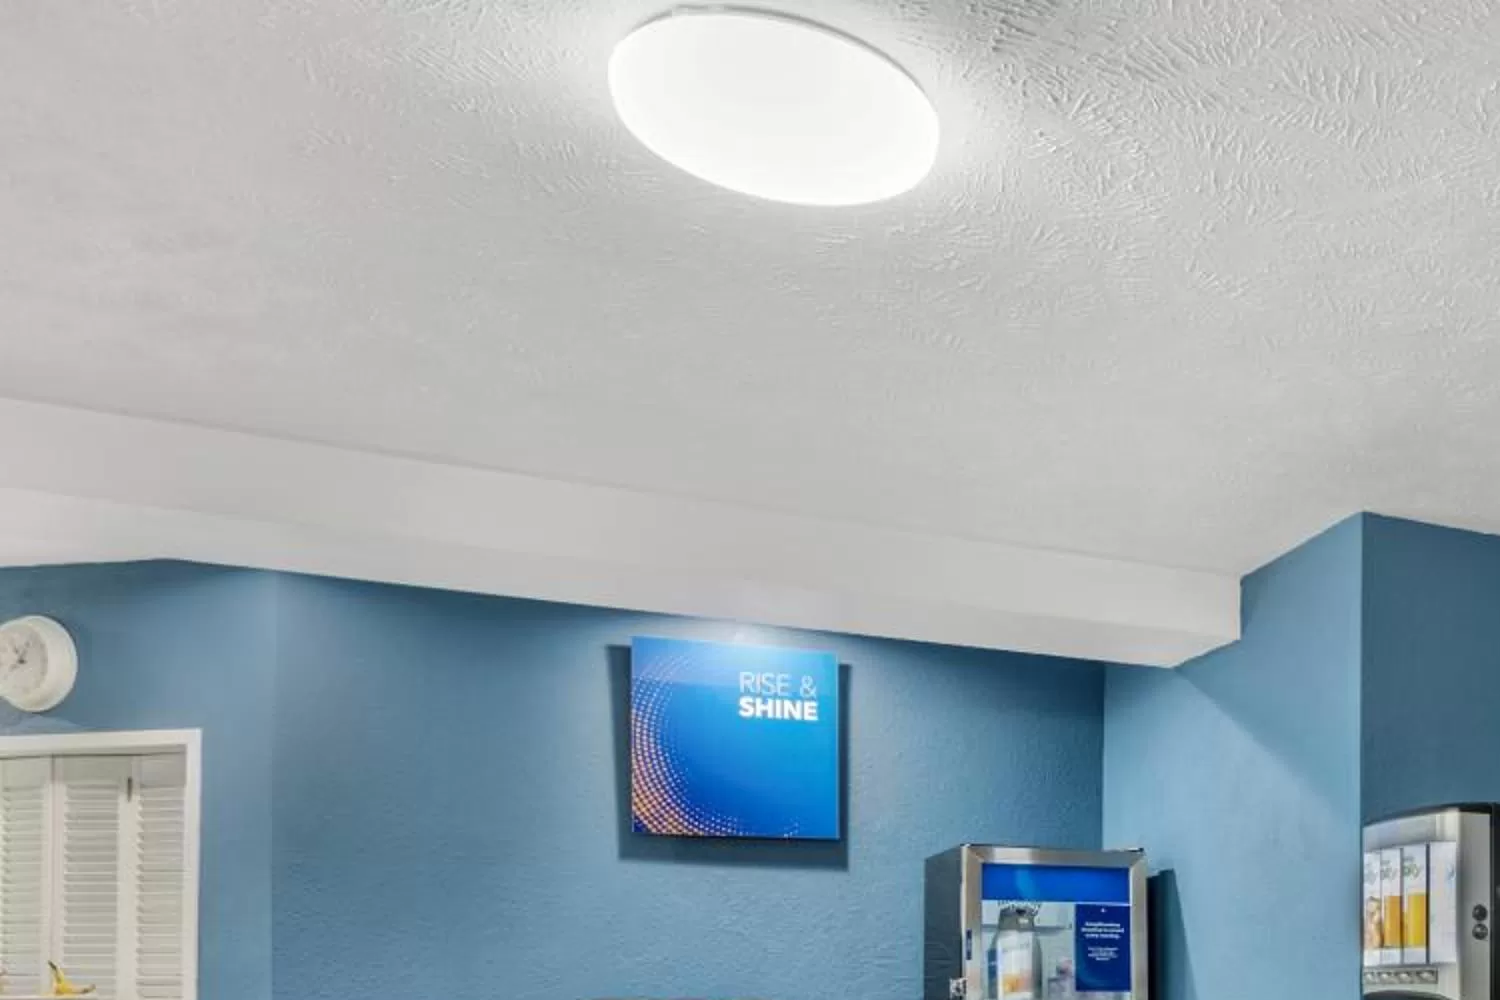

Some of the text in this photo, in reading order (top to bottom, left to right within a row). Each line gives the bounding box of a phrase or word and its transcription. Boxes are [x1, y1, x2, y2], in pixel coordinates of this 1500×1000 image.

[739, 671, 817, 698] RISE &
[738, 695, 818, 720] SHINE
